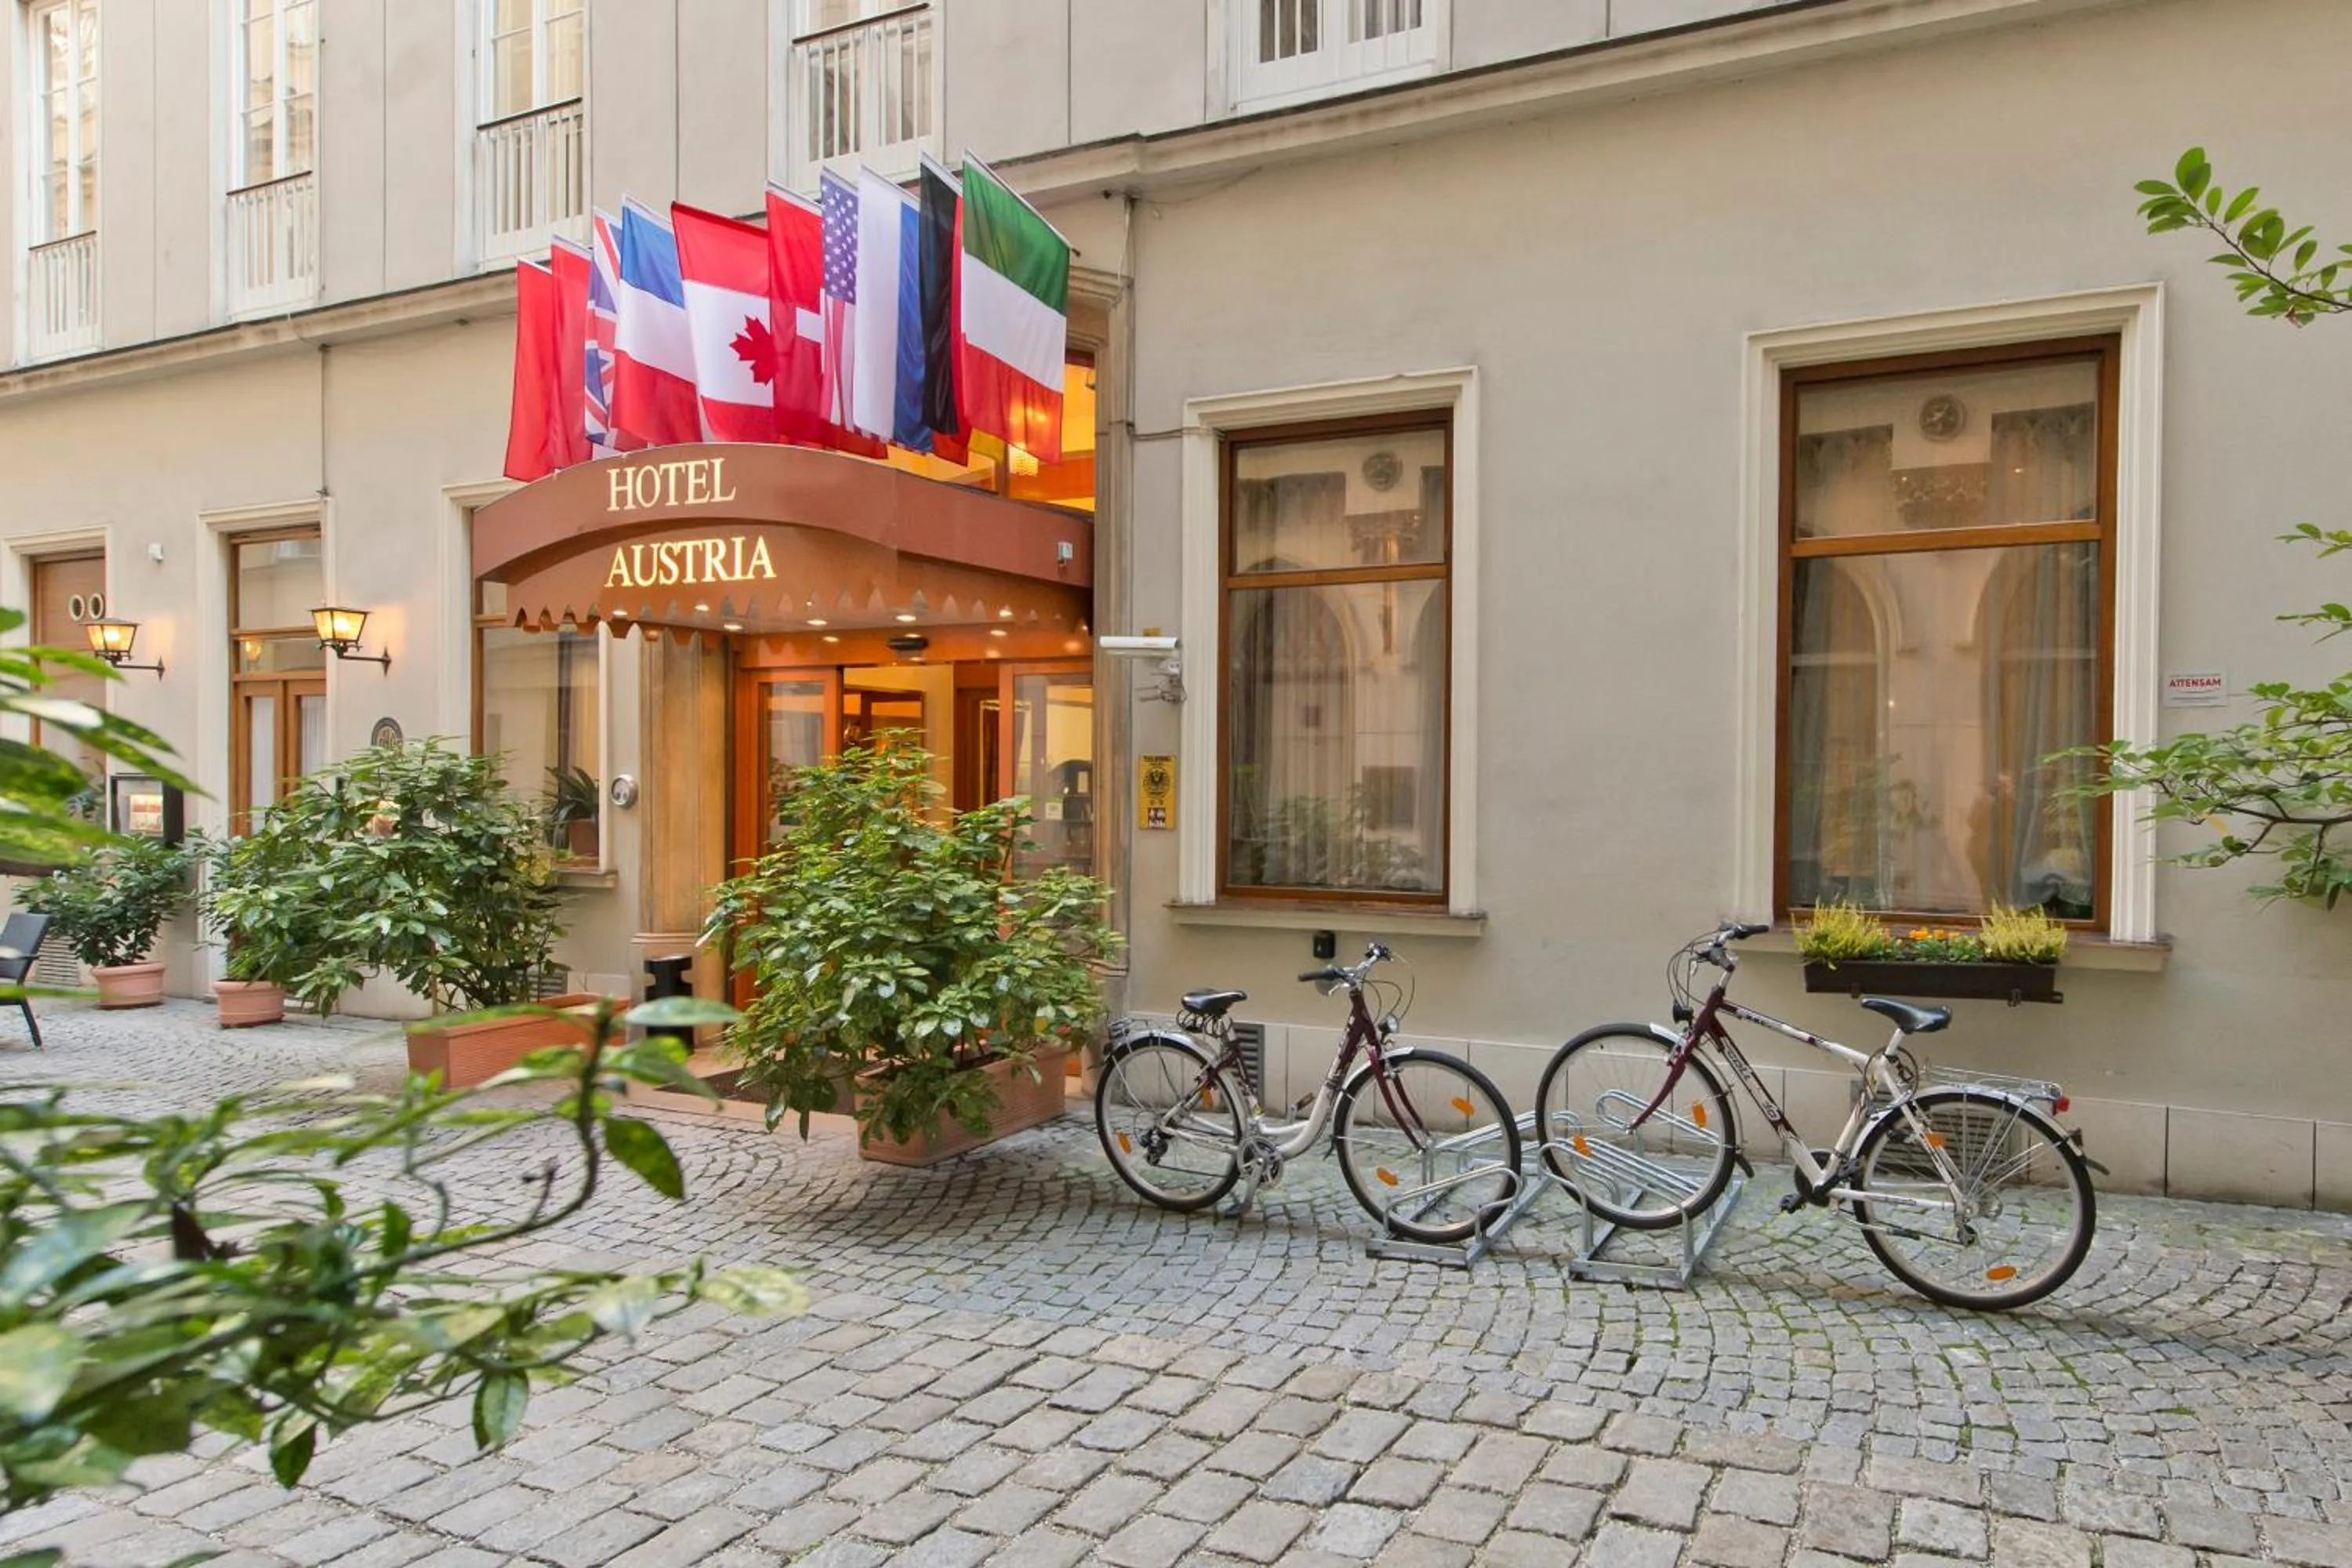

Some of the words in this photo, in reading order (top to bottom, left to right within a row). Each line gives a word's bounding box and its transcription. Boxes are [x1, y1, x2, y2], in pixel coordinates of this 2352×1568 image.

[607, 458, 735, 511] HOTEL
[604, 535, 776, 587] AUSTRIA
[2169, 678, 2221, 688] ATTENSAM
